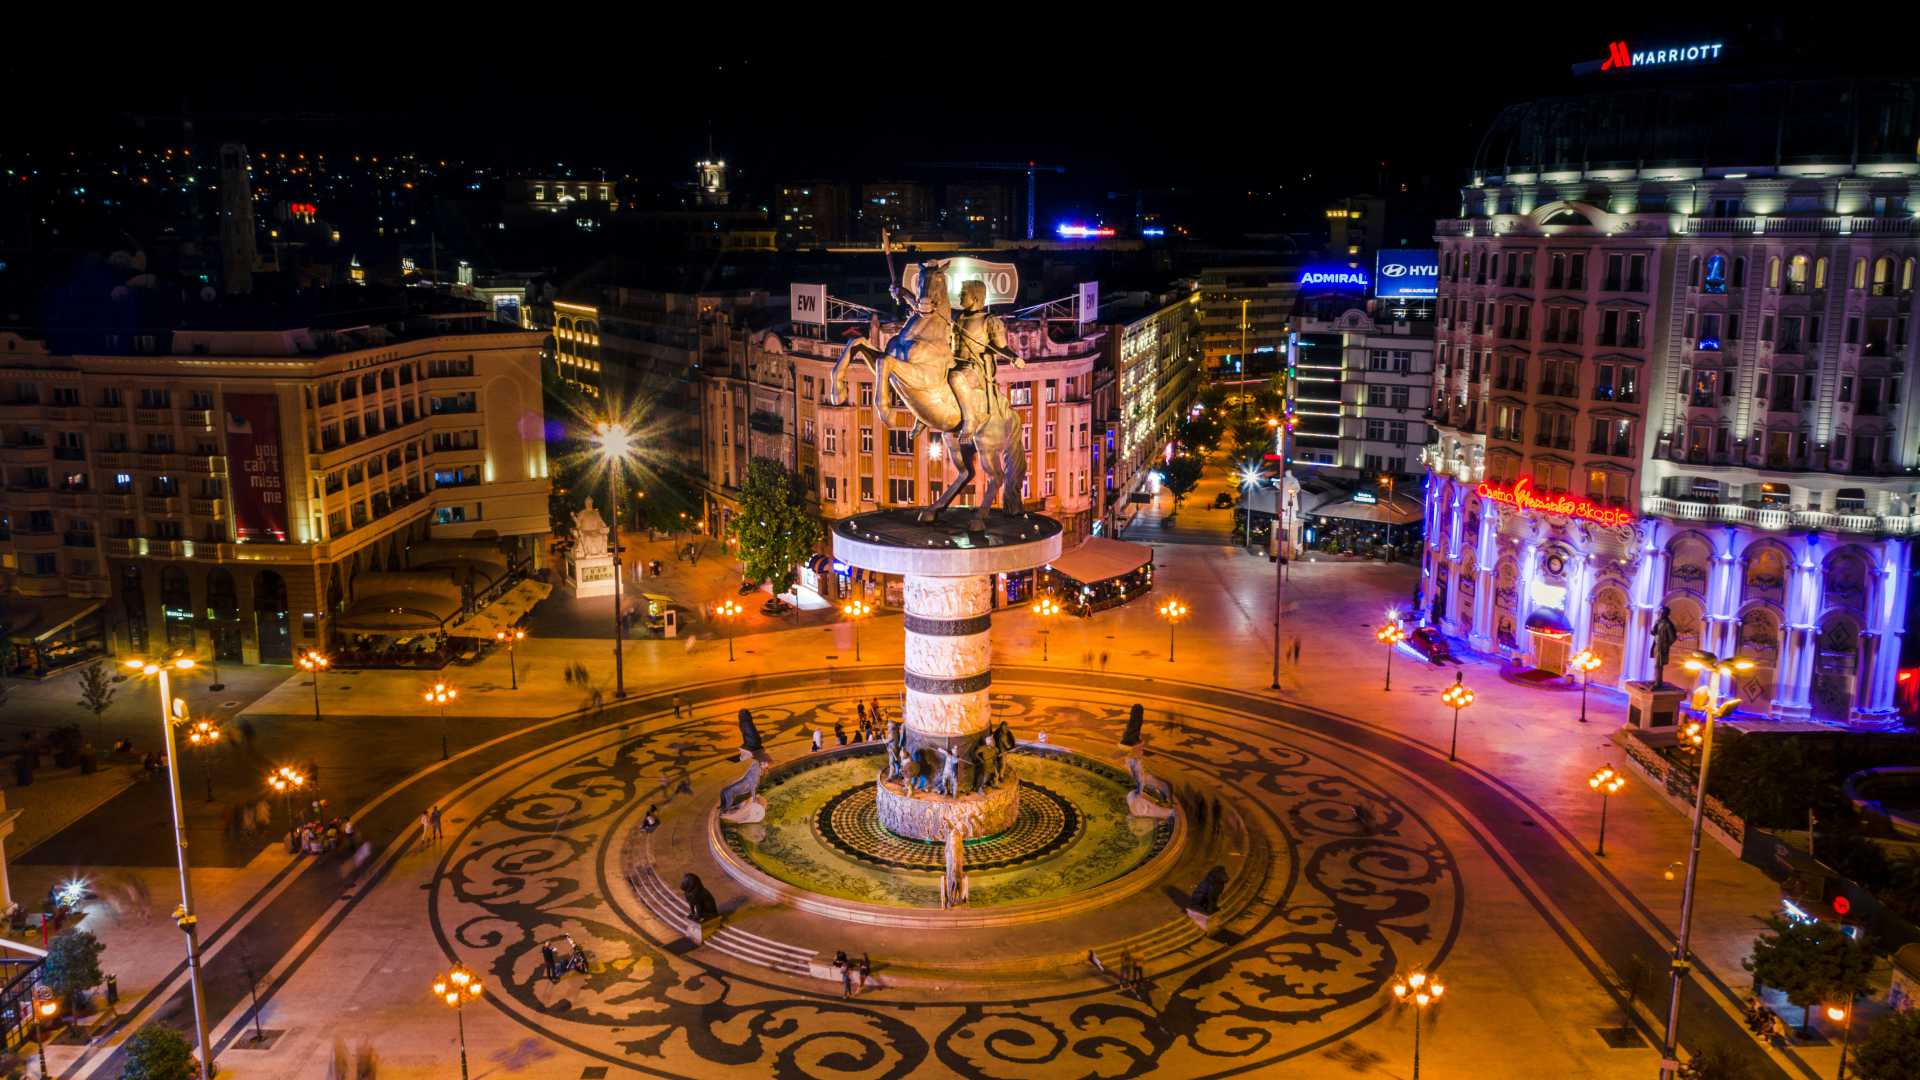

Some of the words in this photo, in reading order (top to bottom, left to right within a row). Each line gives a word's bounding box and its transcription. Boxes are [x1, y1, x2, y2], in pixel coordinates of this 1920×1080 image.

[1632, 44, 1722, 66] MARRIOTT
[1301, 272, 1368, 285] ADMIRAL
[797, 294, 816, 311] EVN
[255, 444, 278, 460] you
[243, 459, 280, 472] can't
[250, 474, 281, 489] miss
[263, 490, 282, 504] me
[1477, 483, 1514, 502] Casino
[1575, 502, 1630, 526] Skopje
